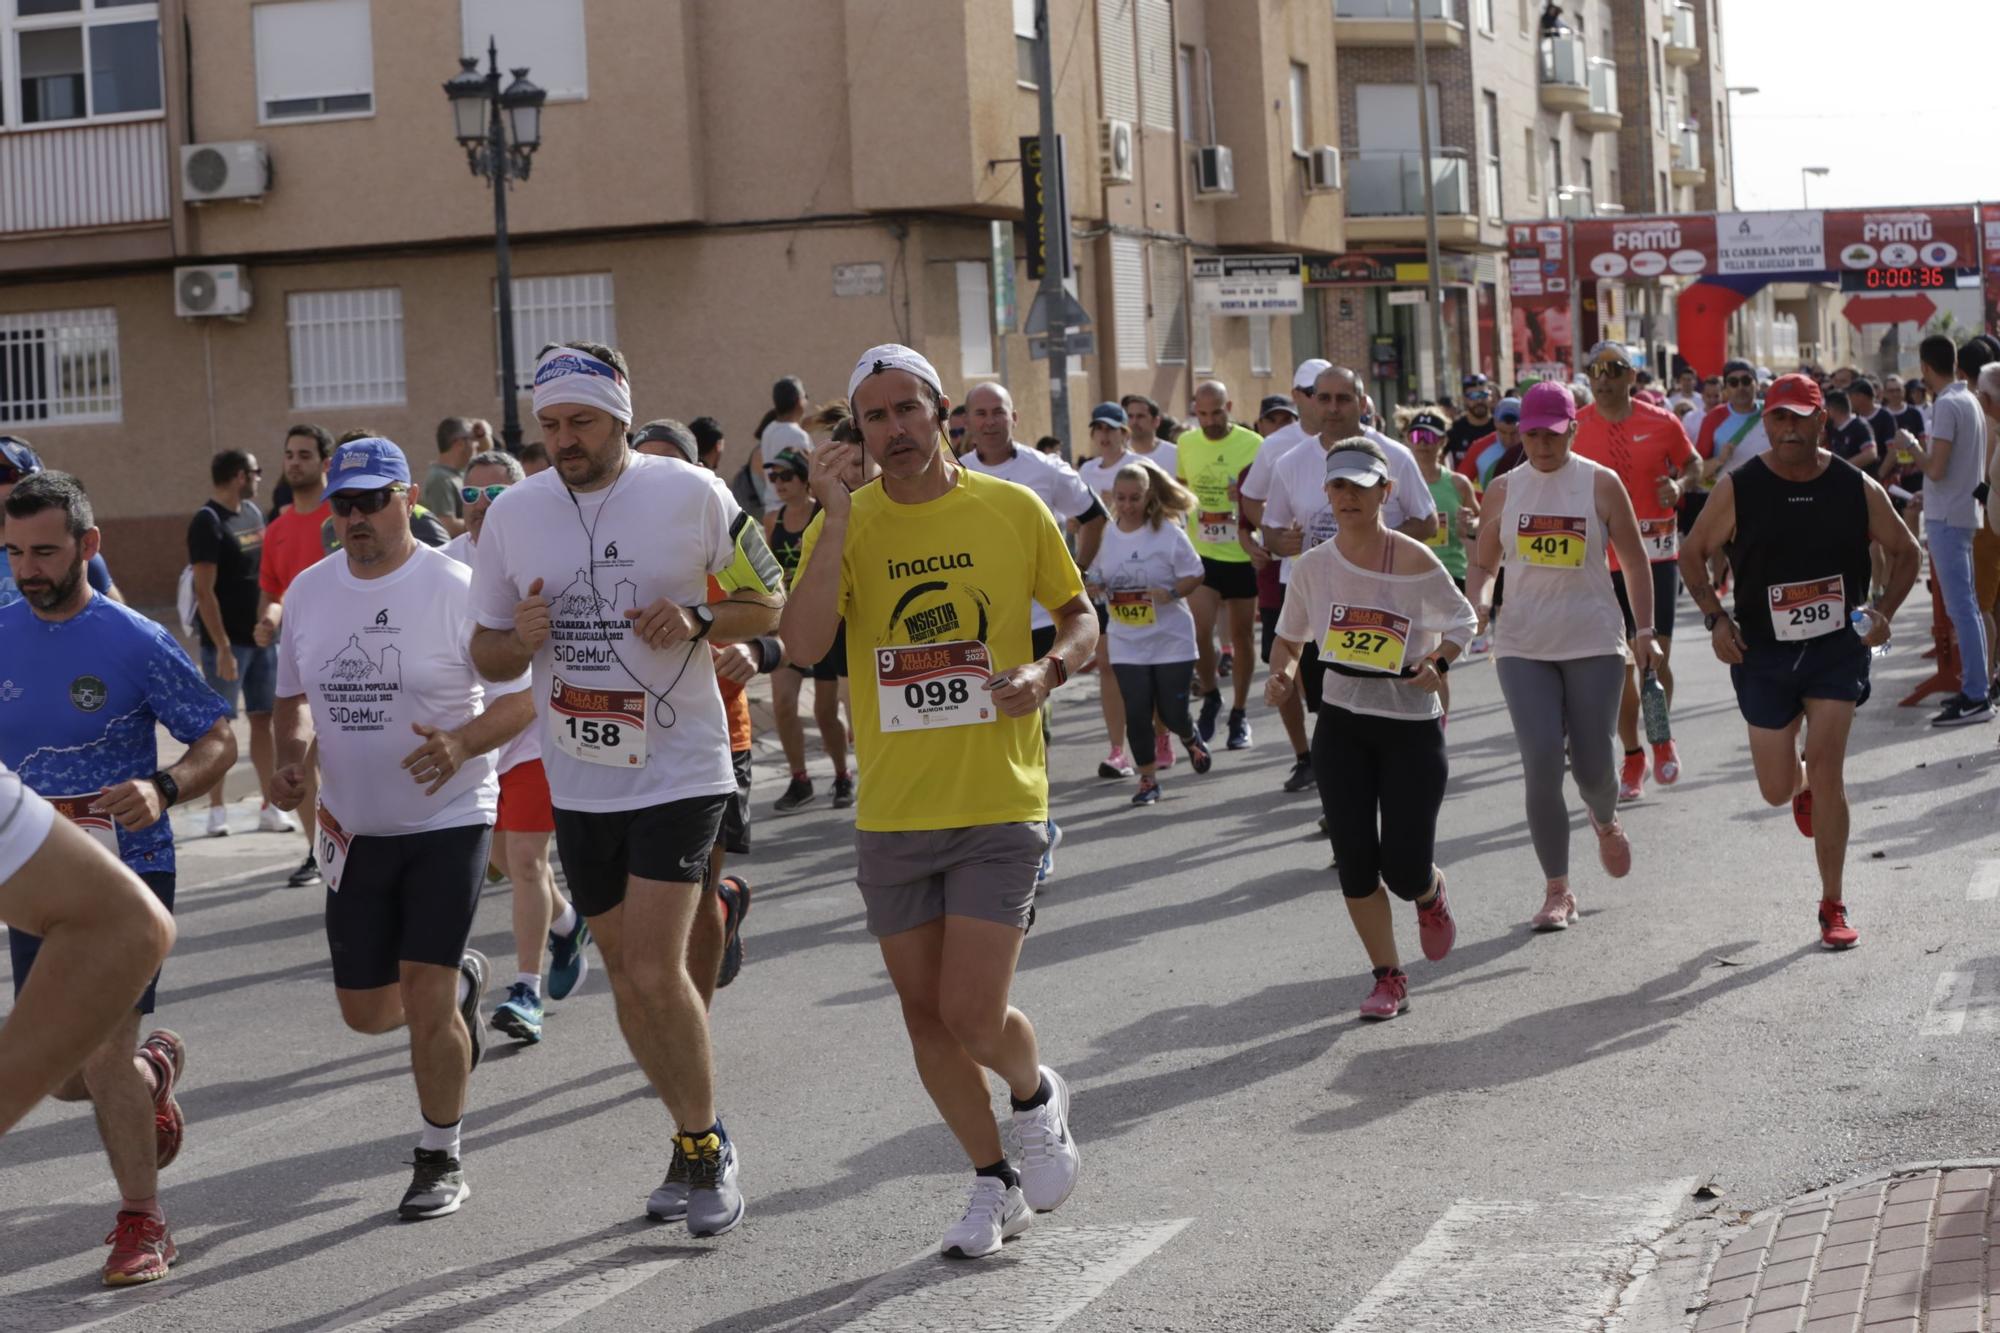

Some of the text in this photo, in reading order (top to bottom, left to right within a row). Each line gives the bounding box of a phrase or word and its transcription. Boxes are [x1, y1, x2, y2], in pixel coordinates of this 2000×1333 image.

[1732, 246, 1777, 258] CARRERA
[1779, 244, 1822, 257] POPULAR
[1867, 266, 1945, 288] 0:00:36
[1204, 525, 1227, 535] 291
[1531, 536, 1569, 555] 401
[887, 552, 974, 580] inacua
[904, 602, 958, 635] INSISTIR
[1115, 606, 1148, 618] 1047
[1789, 603, 1830, 626] 298
[555, 620, 592, 630] CARRERA
[593, 620, 632, 630] POPULAR
[1341, 630, 1389, 654] 327
[554, 645, 613, 663] SiDeMur
[900, 652, 931, 664] VILLA
[934, 650, 951, 660] DE
[327, 683, 363, 692] CARRERA
[364, 682, 399, 692] POPULAR
[904, 678, 969, 709] 098
[329, 706, 385, 723] SiDeMur
[565, 716, 621, 747] 158
